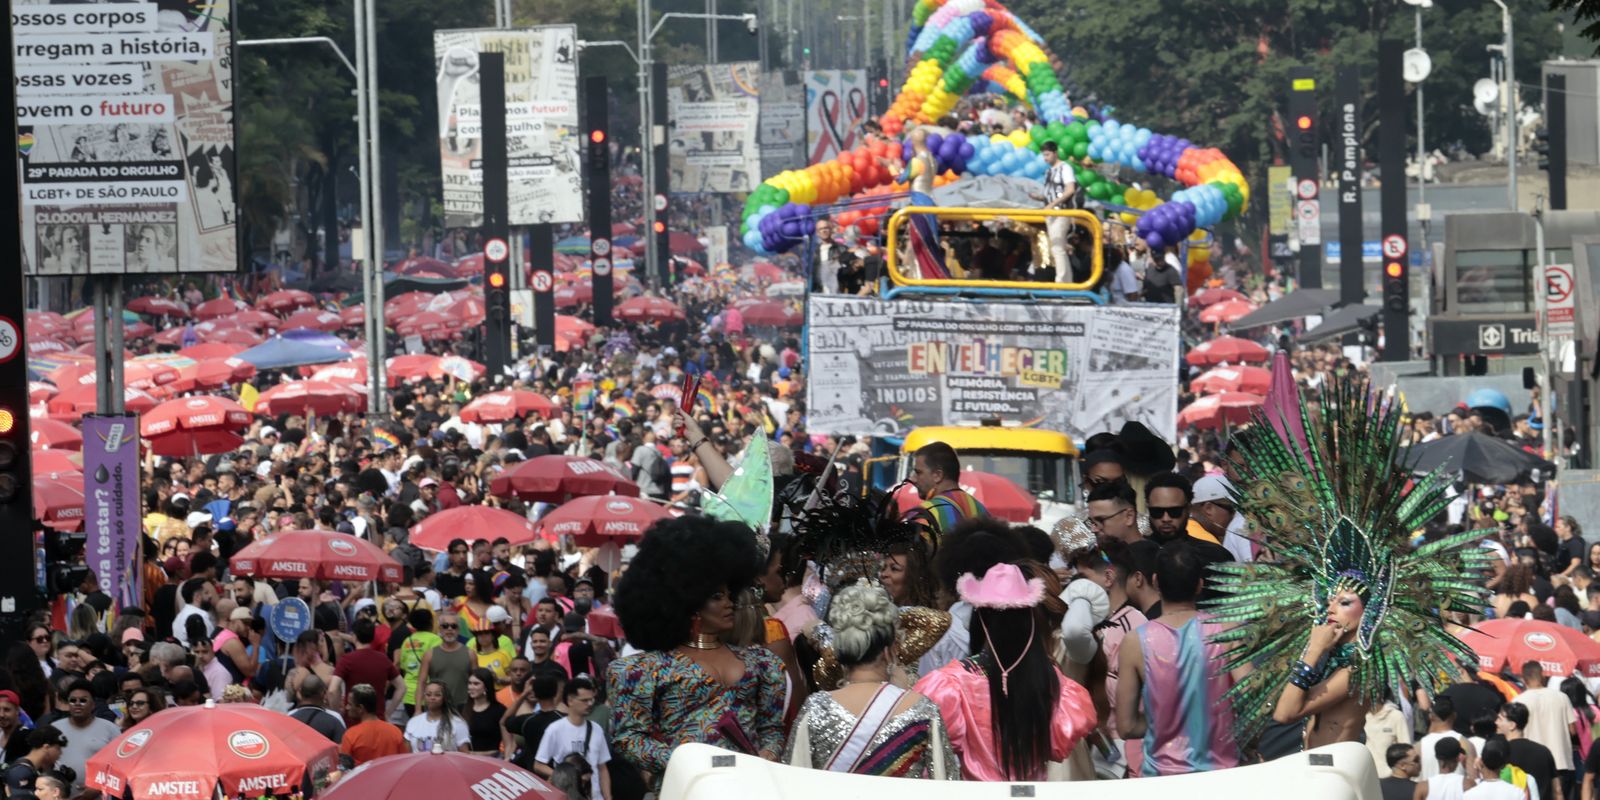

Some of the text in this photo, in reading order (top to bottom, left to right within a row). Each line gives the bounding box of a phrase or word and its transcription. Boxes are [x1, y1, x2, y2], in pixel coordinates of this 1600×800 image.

[12, 11, 147, 29] ossos corpos
[17, 36, 207, 60] rregam a história,
[16, 74, 66, 88] ssas
[73, 72, 133, 87] vozes
[17, 100, 166, 117] ovem o futuro
[531, 105, 568, 114] futuro
[1341, 102, 1359, 203] R. Pamplona
[48, 166, 98, 178] PARADA
[100, 165, 119, 176] DO
[120, 164, 179, 176] ORGULHO
[29, 184, 178, 200] LGBT+ DE SÃO PAULO
[35, 211, 177, 224] CLODOVIL HERNANDEZ
[910, 321, 945, 330] PARADA
[945, 322, 958, 330] DO
[958, 323, 999, 332] ORGULHO
[907, 339, 1068, 376] ENVELHECER
[948, 377, 1007, 390] MEMÓRIA,
[1023, 372, 1060, 384] LGBT+
[876, 386, 938, 404] INDIOS
[111, 462, 124, 517] cuidado.
[57, 507, 84, 518] AMSTEL
[95, 488, 111, 556] testar?
[112, 521, 124, 535] só
[604, 521, 639, 532] AMSTEL
[115, 538, 125, 571] tabu,
[271, 561, 308, 573] AMSTEL
[334, 564, 369, 577] AMSTEL
[1540, 660, 1563, 673] STEL
[148, 780, 199, 796] AMSTEL
[238, 773, 289, 792] AMSTEL
